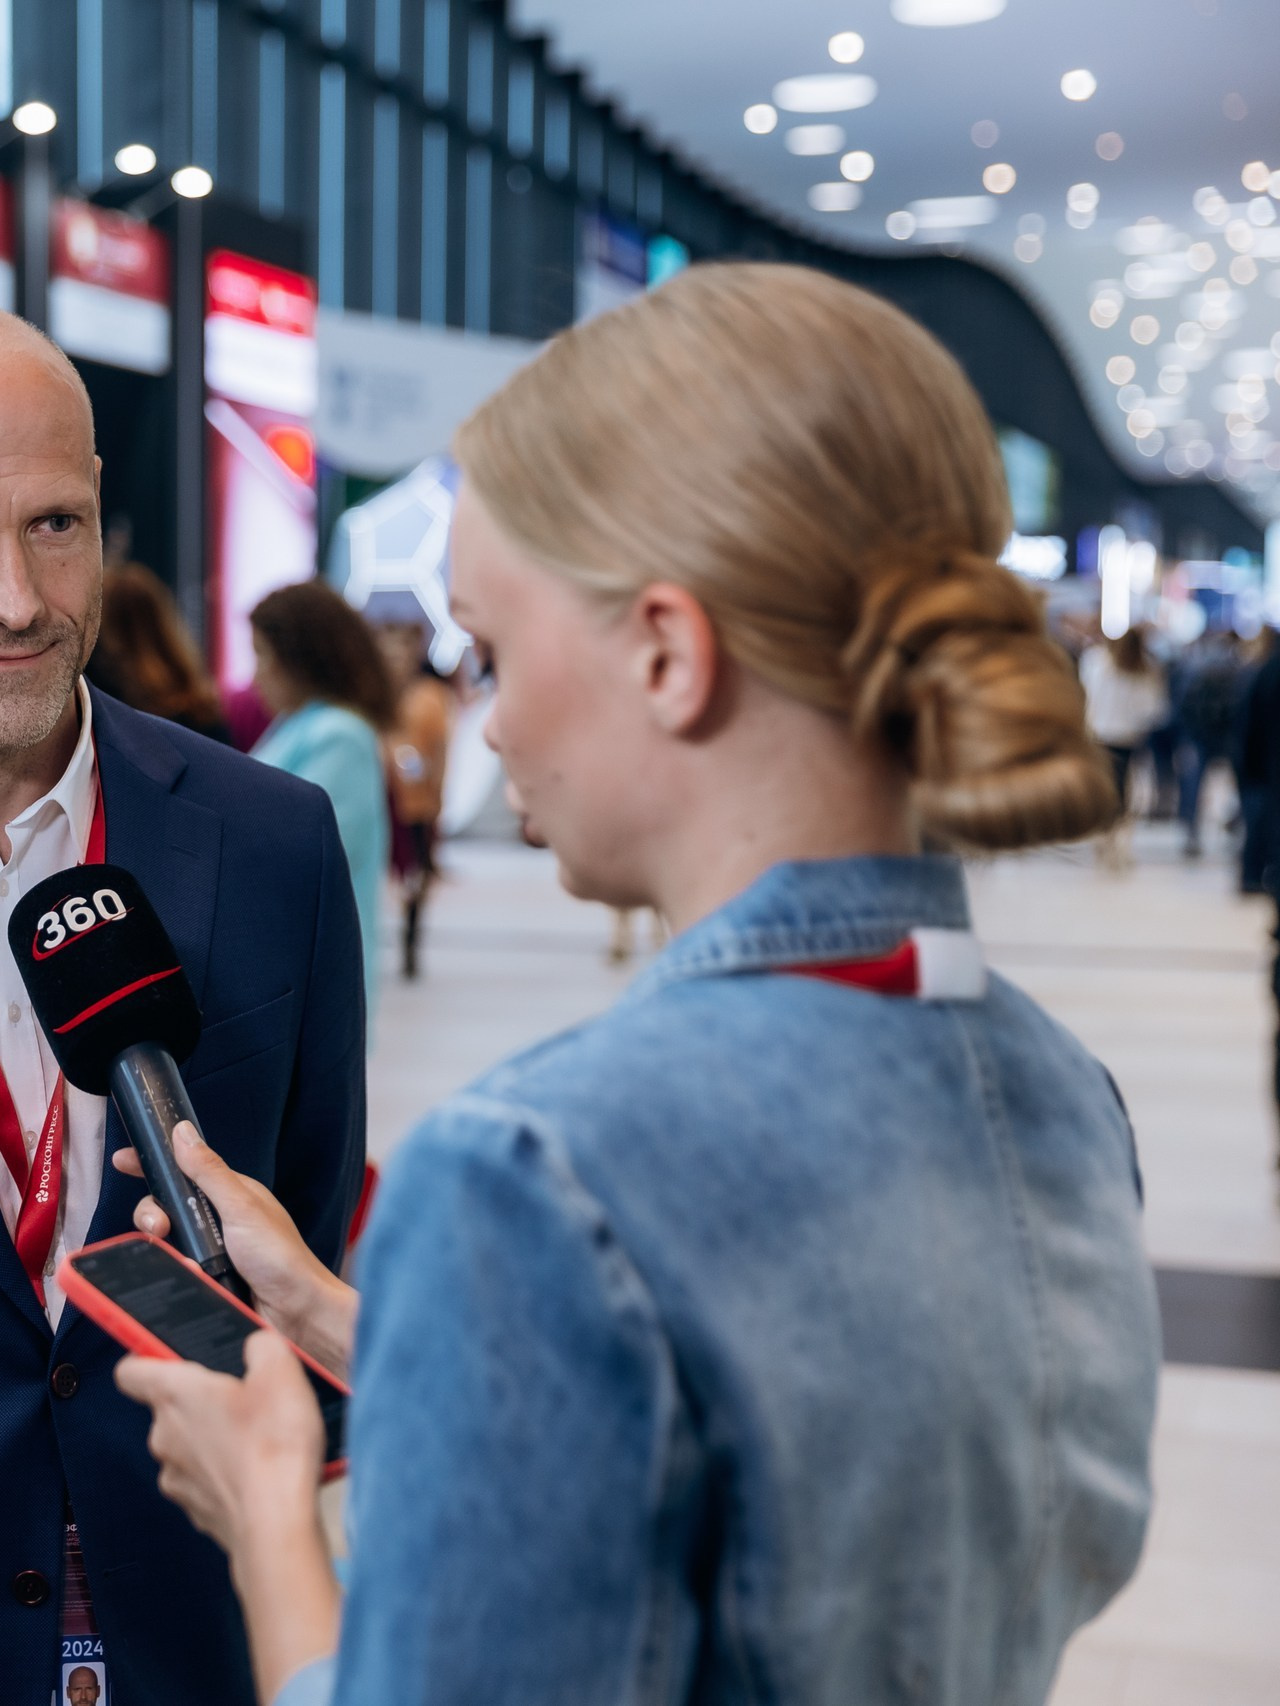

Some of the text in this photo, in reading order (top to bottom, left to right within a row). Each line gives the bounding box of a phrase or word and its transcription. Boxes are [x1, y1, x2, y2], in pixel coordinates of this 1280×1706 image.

[37, 888, 127, 949] 360
[39, 1104, 59, 1189] РОСКОНГРЕСС
[61, 1639, 104, 1658] 2024
